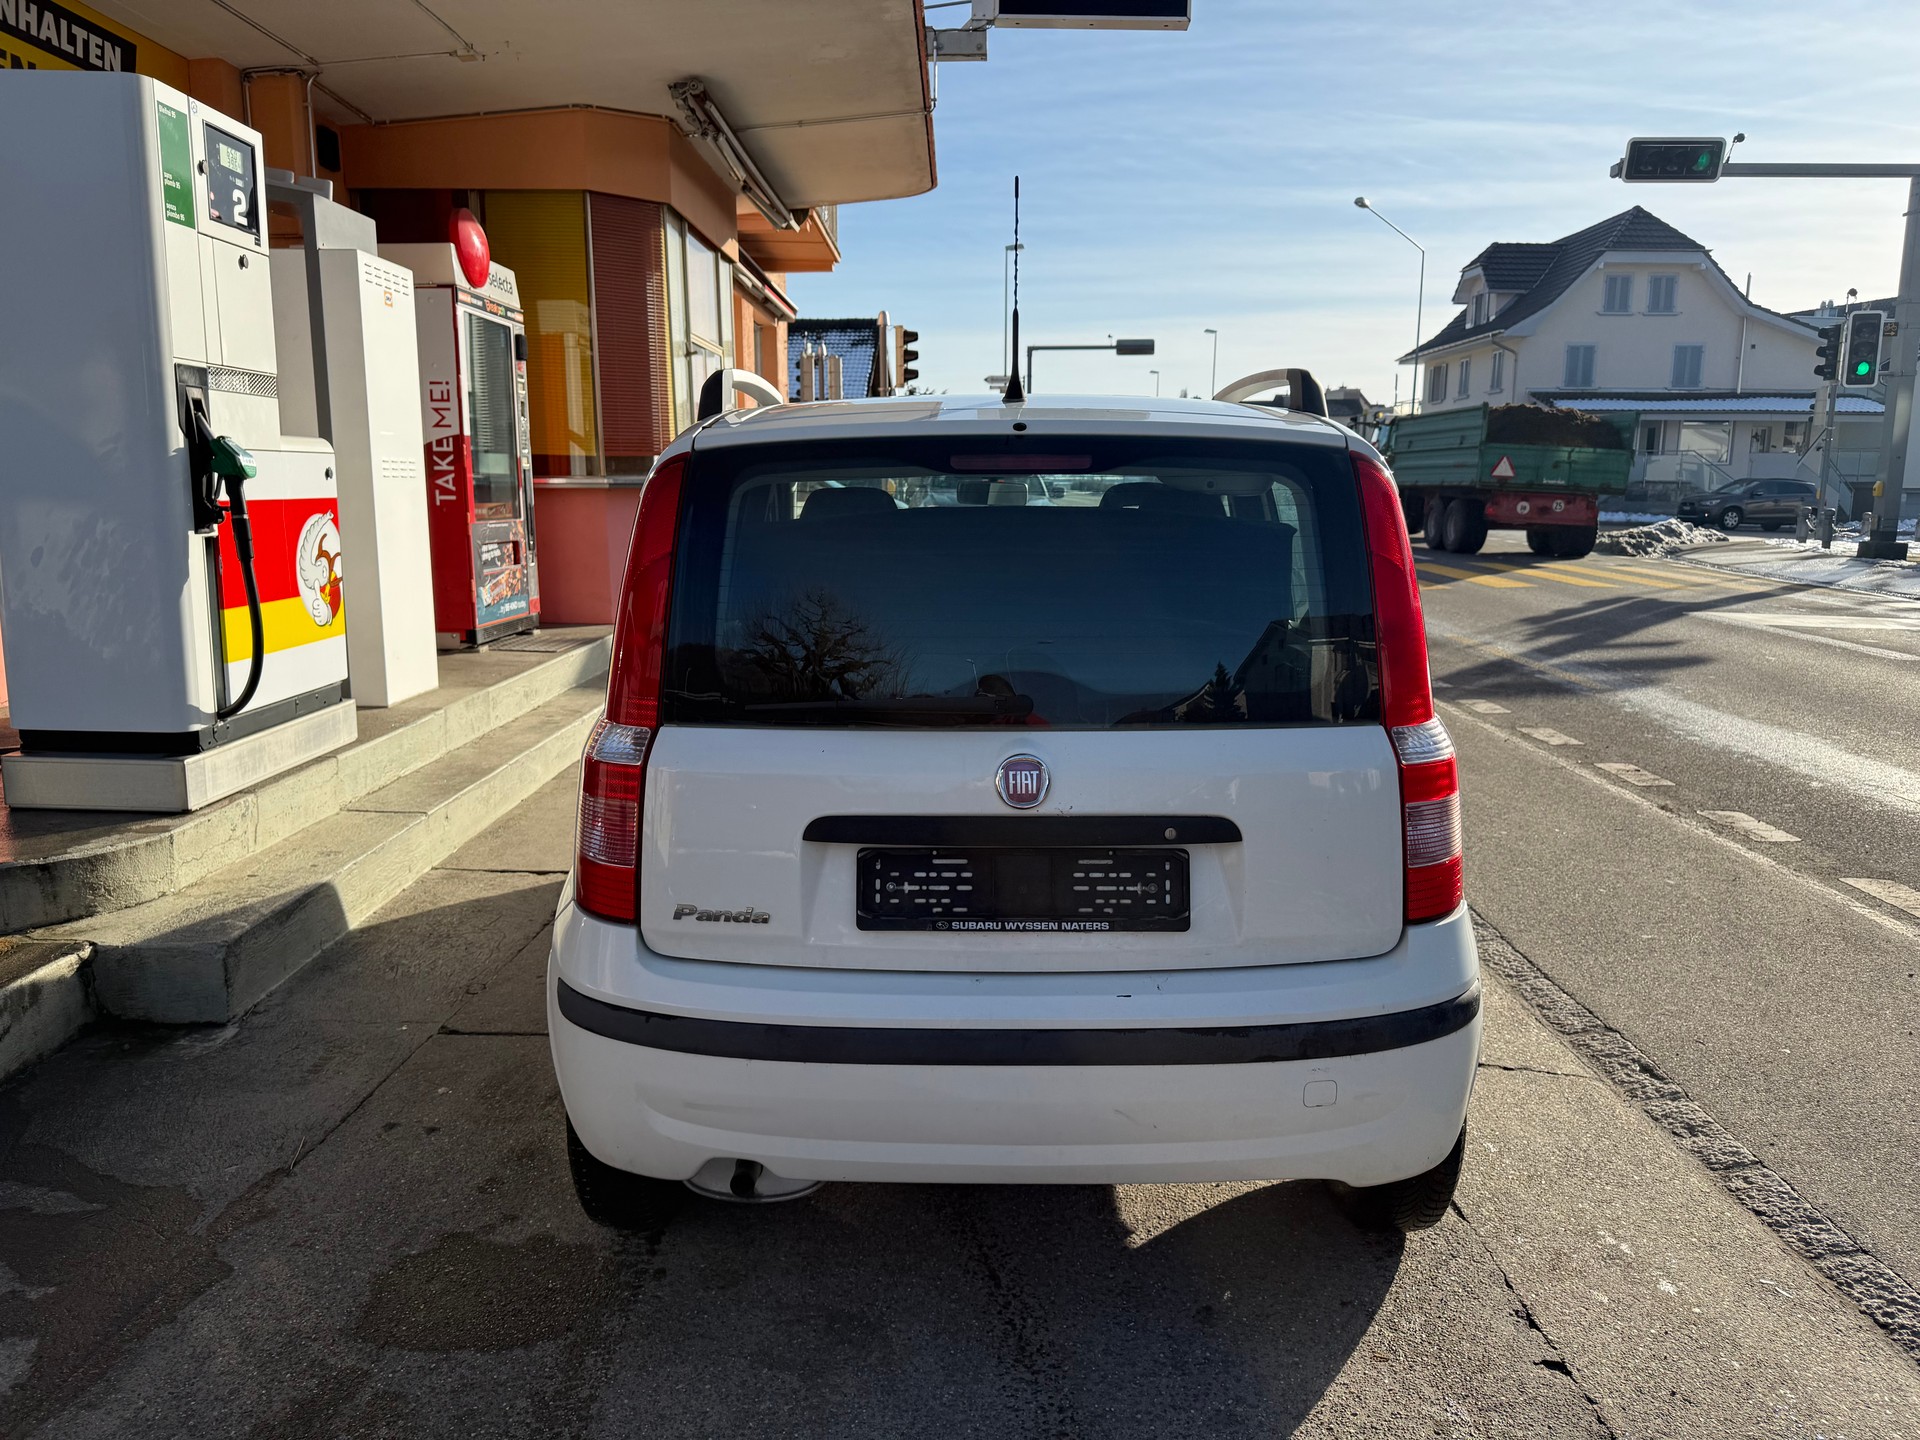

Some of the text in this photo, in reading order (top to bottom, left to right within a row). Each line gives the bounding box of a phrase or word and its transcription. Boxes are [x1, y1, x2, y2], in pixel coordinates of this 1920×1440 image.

[488, 271, 513, 295] selecta
[429, 381, 457, 506] TAKE ME!
[1554, 501, 1563, 510] 25
[1009, 771, 1039, 794] FIAT
[673, 904, 771, 924] Panda
[951, 921, 1110, 930] SUBARU WYSSEN NATERS
